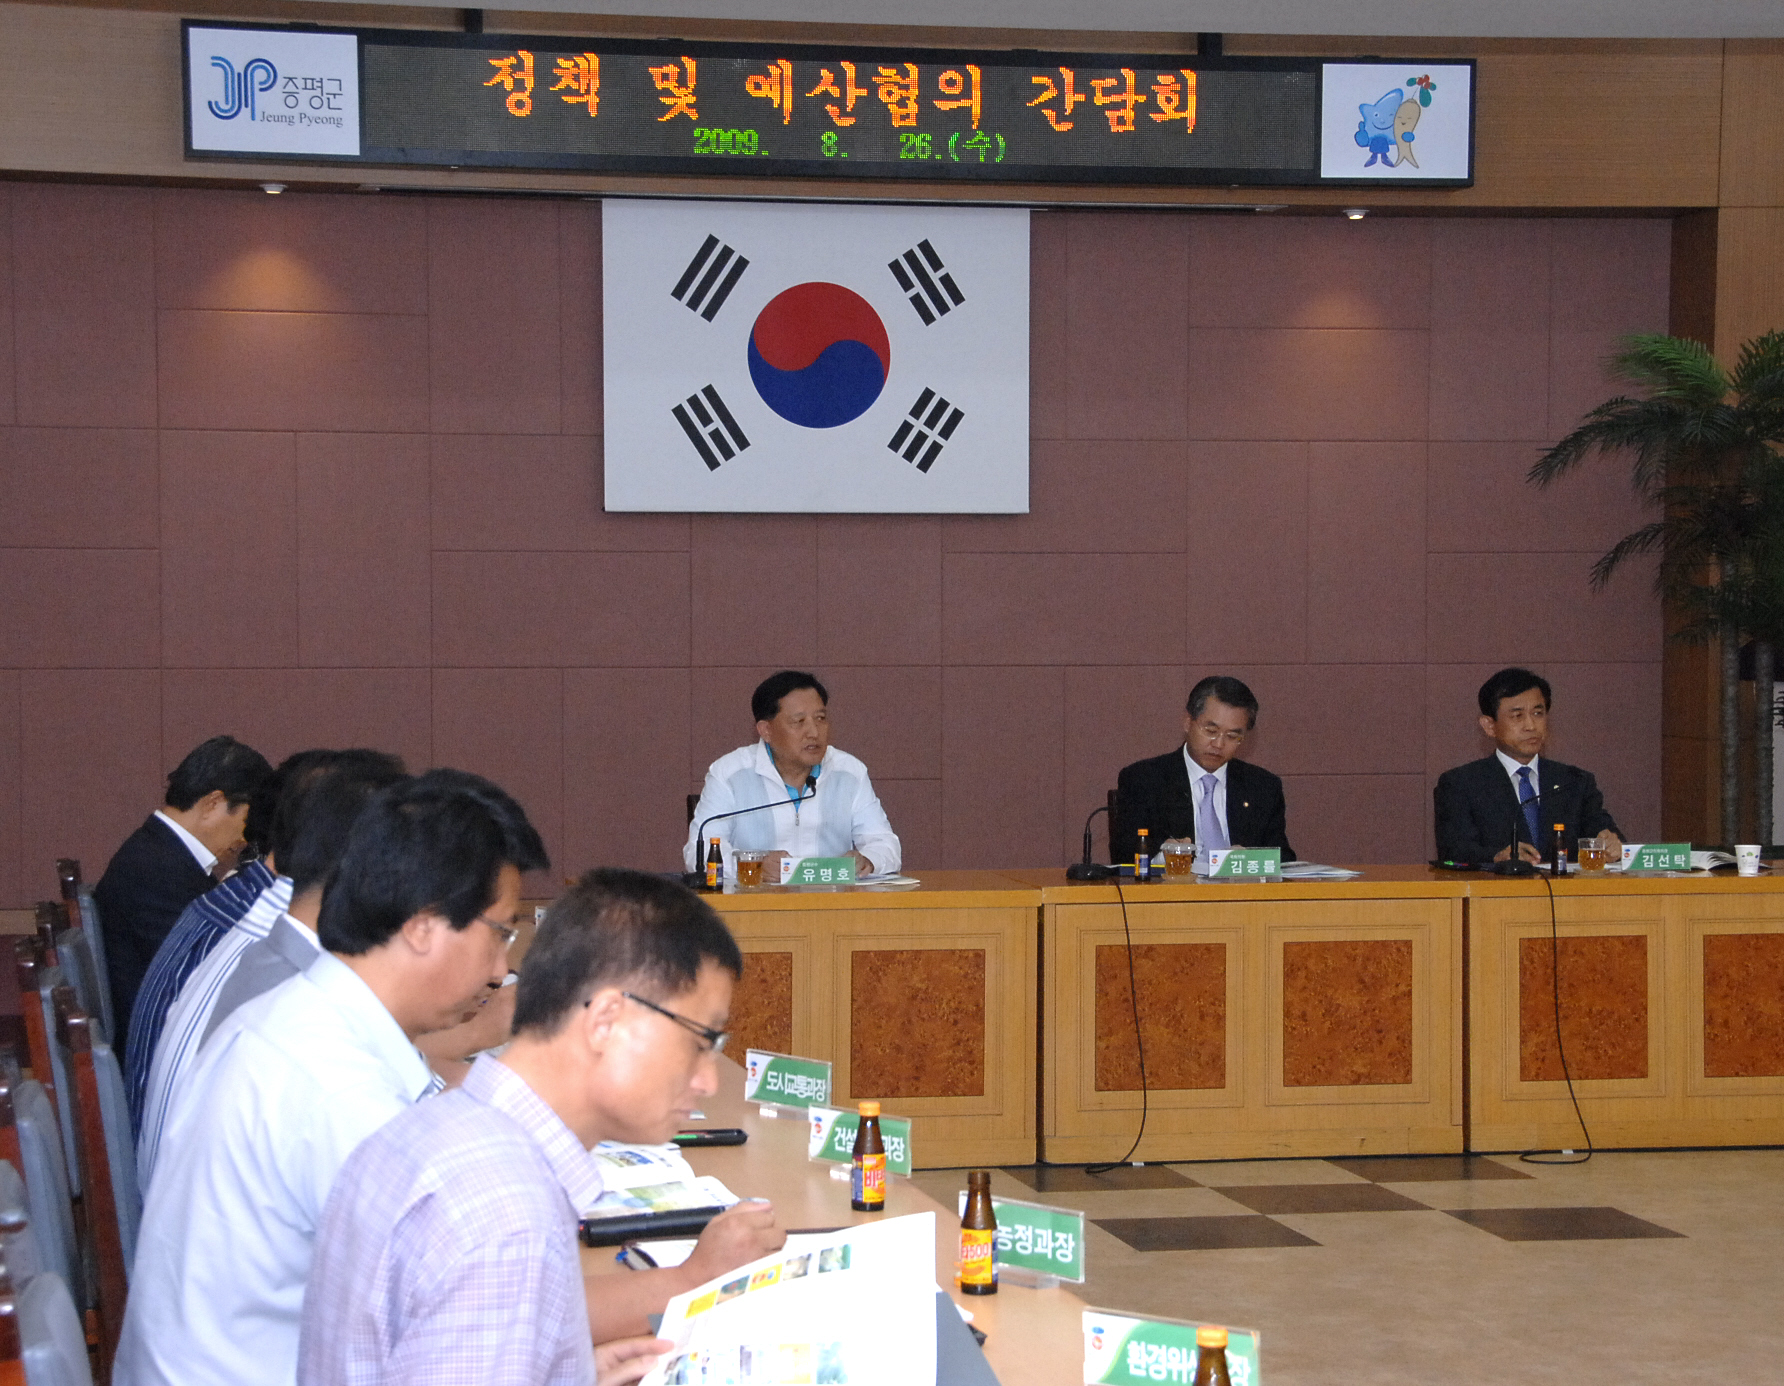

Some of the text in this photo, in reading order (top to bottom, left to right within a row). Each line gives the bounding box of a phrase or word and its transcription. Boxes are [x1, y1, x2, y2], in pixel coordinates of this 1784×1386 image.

[281, 76, 344, 111] 증평군
[483, 50, 1197, 133] 정책 및 예산협의 간담회
[260, 111, 344, 128] Jeung Pyeong
[693, 128, 769, 156] 2009.
[821, 131, 849, 158] 8.
[802, 868, 850, 882] 유명호
[766, 1070, 827, 1102] 도시교통과장
